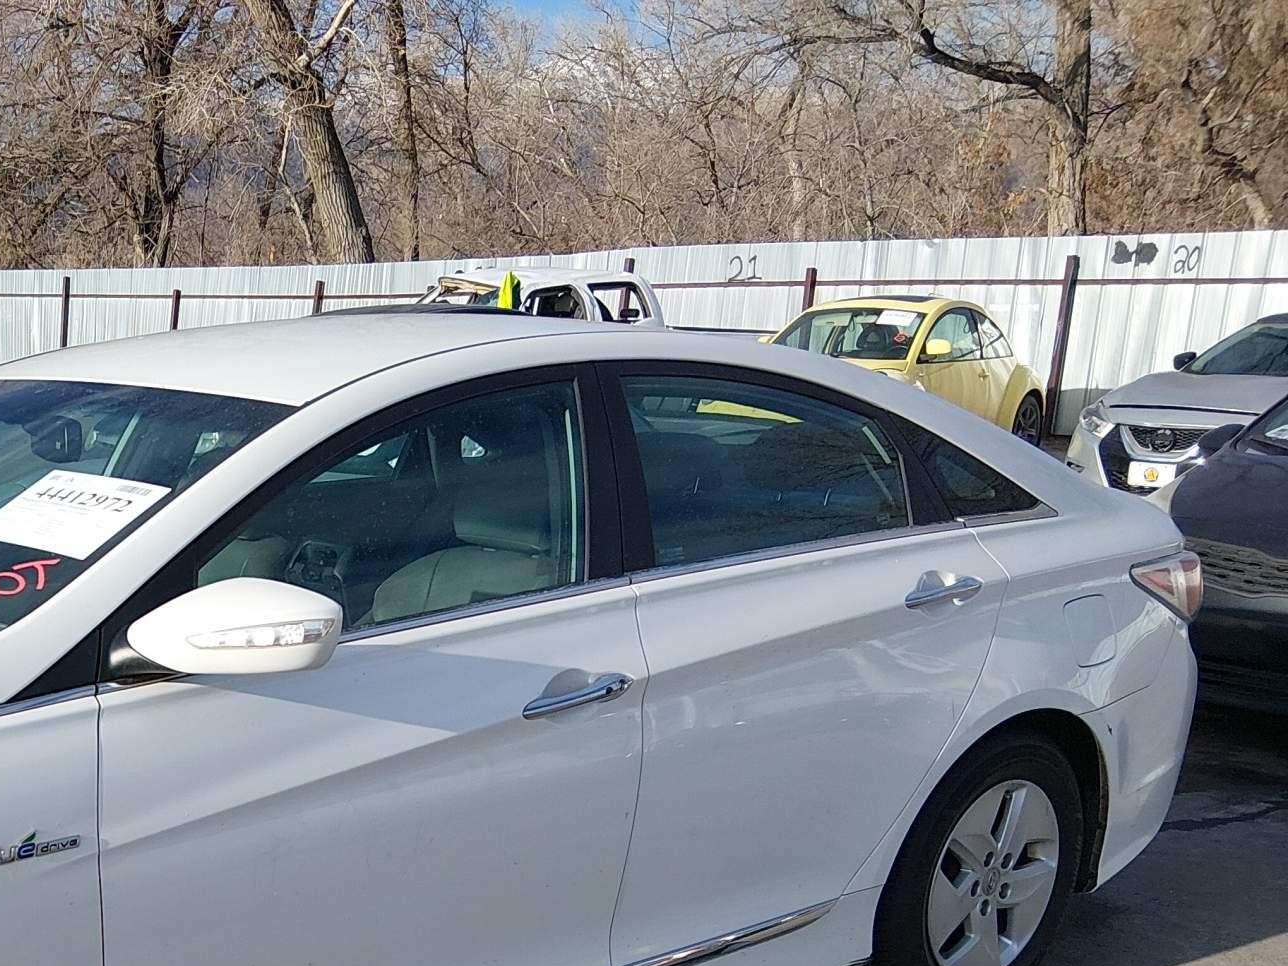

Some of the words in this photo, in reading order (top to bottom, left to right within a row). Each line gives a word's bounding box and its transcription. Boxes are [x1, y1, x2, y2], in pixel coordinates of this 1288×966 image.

[727, 255, 763, 283] 21
[1173, 245, 1202, 275] 20
[35, 485, 133, 513] 44412972
